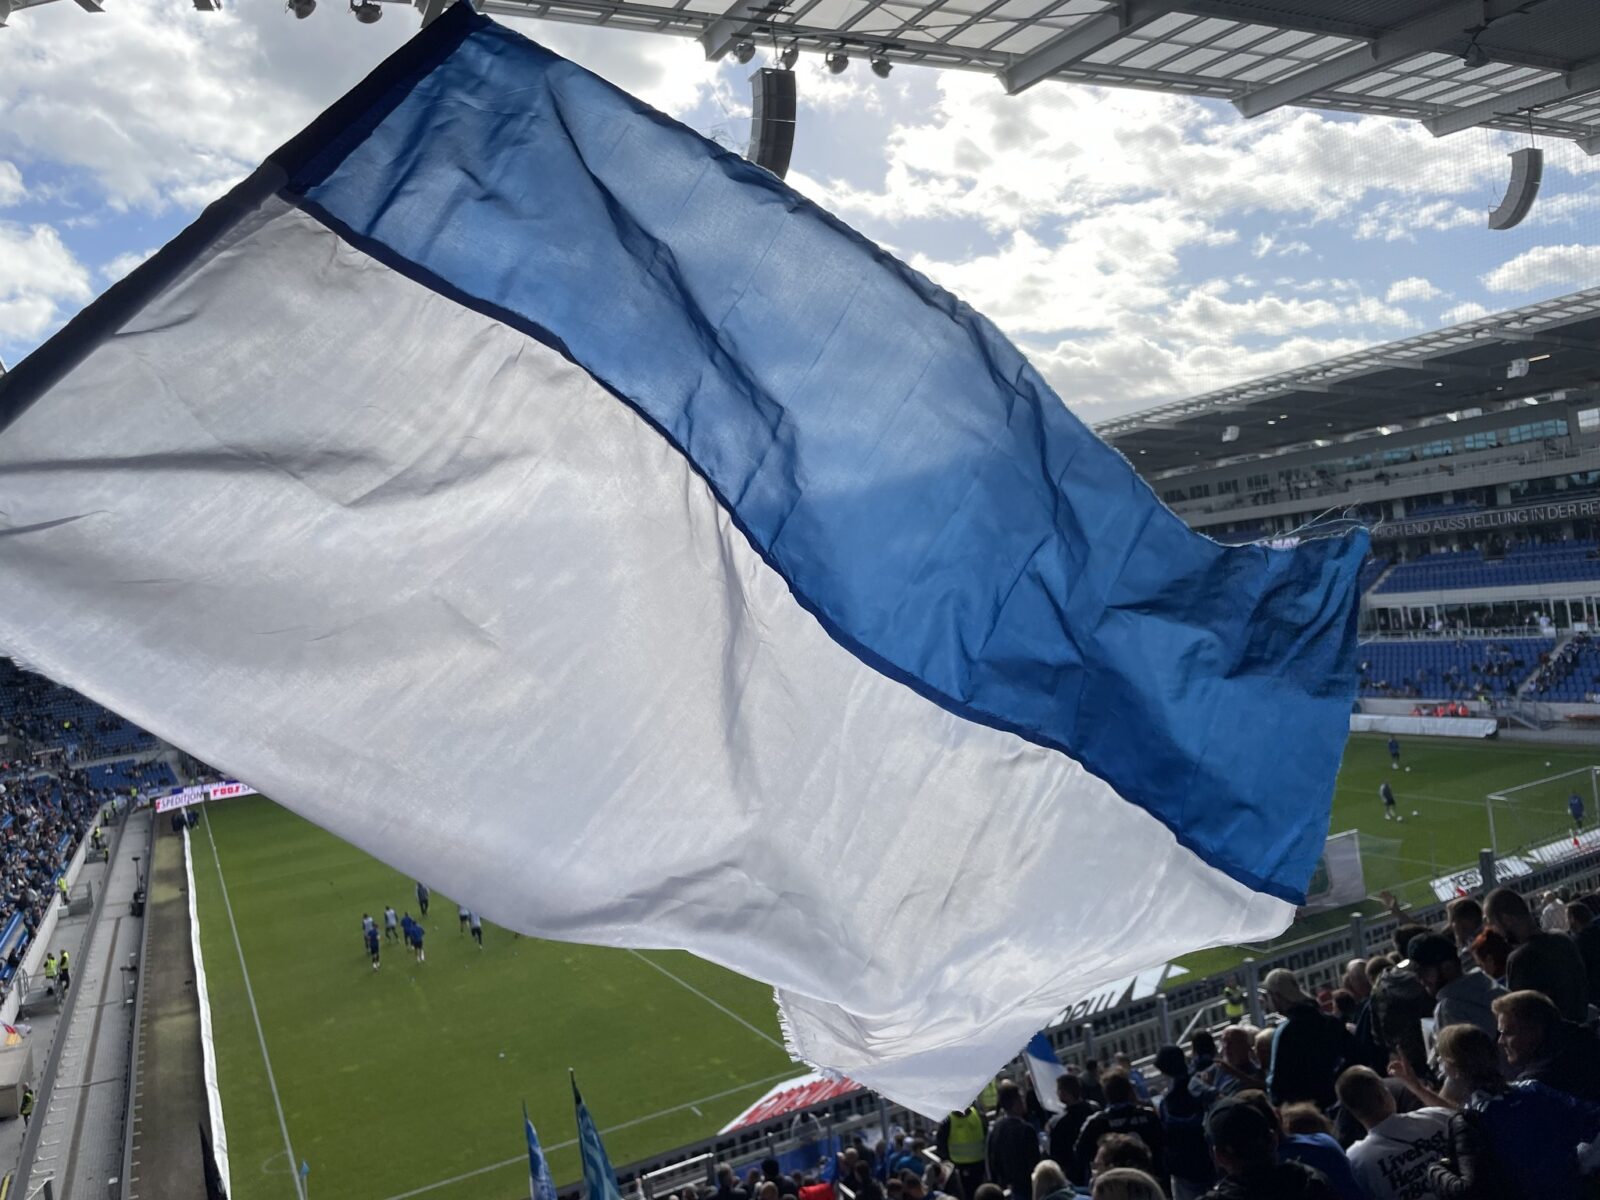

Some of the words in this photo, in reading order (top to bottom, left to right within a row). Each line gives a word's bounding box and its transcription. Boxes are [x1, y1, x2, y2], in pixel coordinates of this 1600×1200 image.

[1405, 522, 1430, 535] END
[1433, 510, 1528, 532] AUSSTELLUNG
[1531, 508, 1545, 521] IN
[1548, 503, 1577, 519] DER
[1580, 501, 1600, 516] RE
